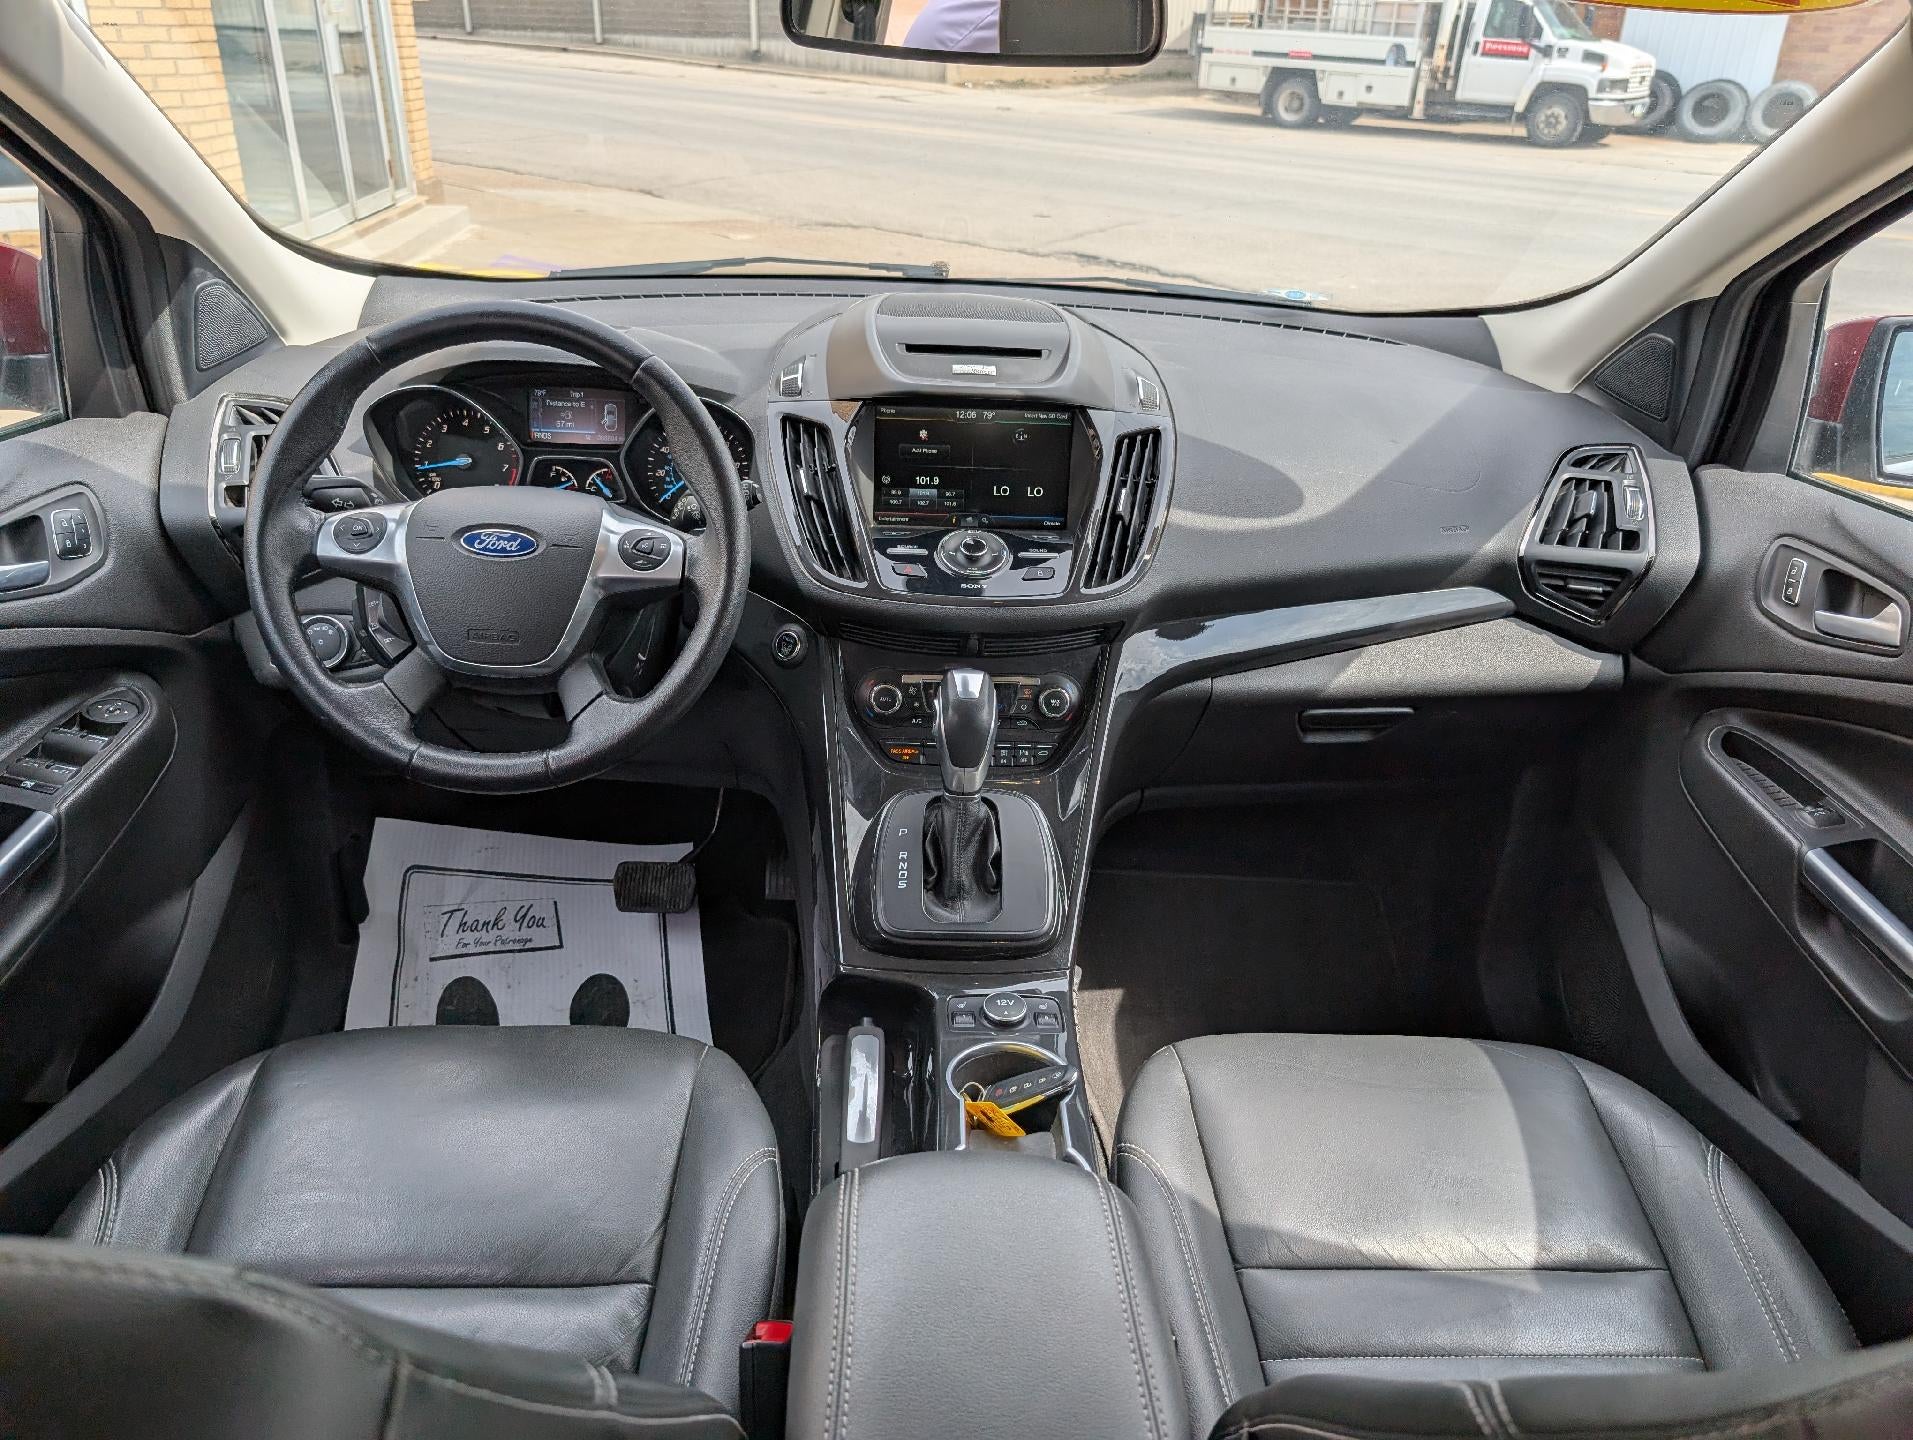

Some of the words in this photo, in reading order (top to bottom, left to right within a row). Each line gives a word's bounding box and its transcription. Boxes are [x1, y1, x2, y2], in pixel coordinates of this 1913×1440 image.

[441, 425, 448, 433] 3
[497, 442, 505, 451] 6
[502, 464, 509, 472] 7
[655, 469, 666, 477] 20
[434, 481, 441, 489] 0
[915, 476, 940, 485] 101.9
[993, 485, 1010, 496] LO
[1027, 486, 1044, 497] LO
[474, 531, 521, 551] Ford
[898, 828, 908, 836] P
[898, 851, 908, 860] R
[898, 861, 908, 870] N
[898, 870, 908, 879] D
[897, 880, 908, 889] S
[441, 906, 507, 938] Thank
[513, 903, 546, 932] You
[456, 938, 471, 949] For
[474, 936, 490, 948] Your
[493, 935, 533, 947] Patronage
